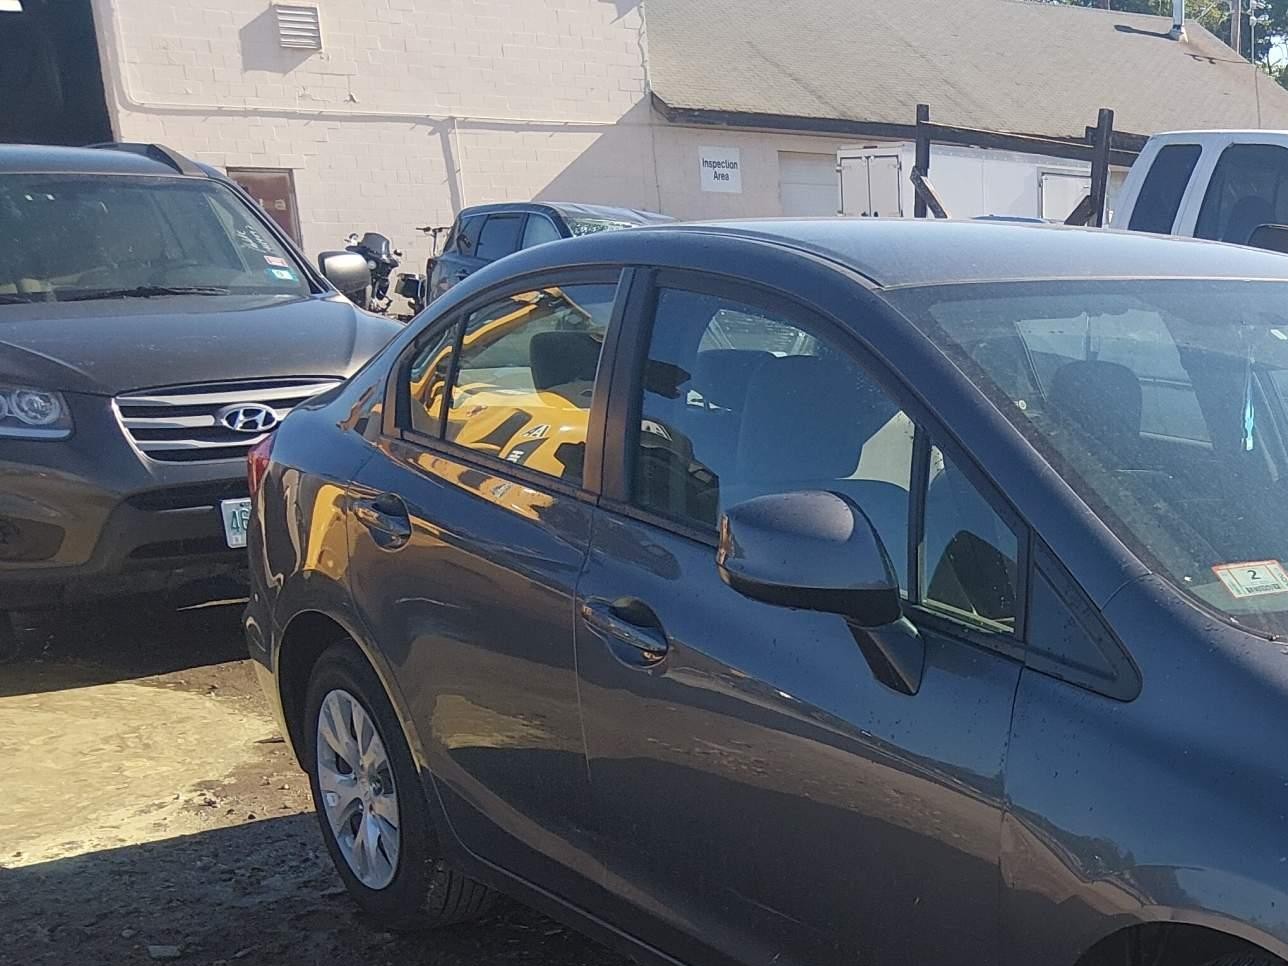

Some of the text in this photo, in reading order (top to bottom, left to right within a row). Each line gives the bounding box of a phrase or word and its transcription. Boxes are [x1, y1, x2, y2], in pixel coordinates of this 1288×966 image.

[702, 157, 738, 170] Inspection
[713, 170, 730, 181] Area
[1247, 569, 1262, 580] 2
